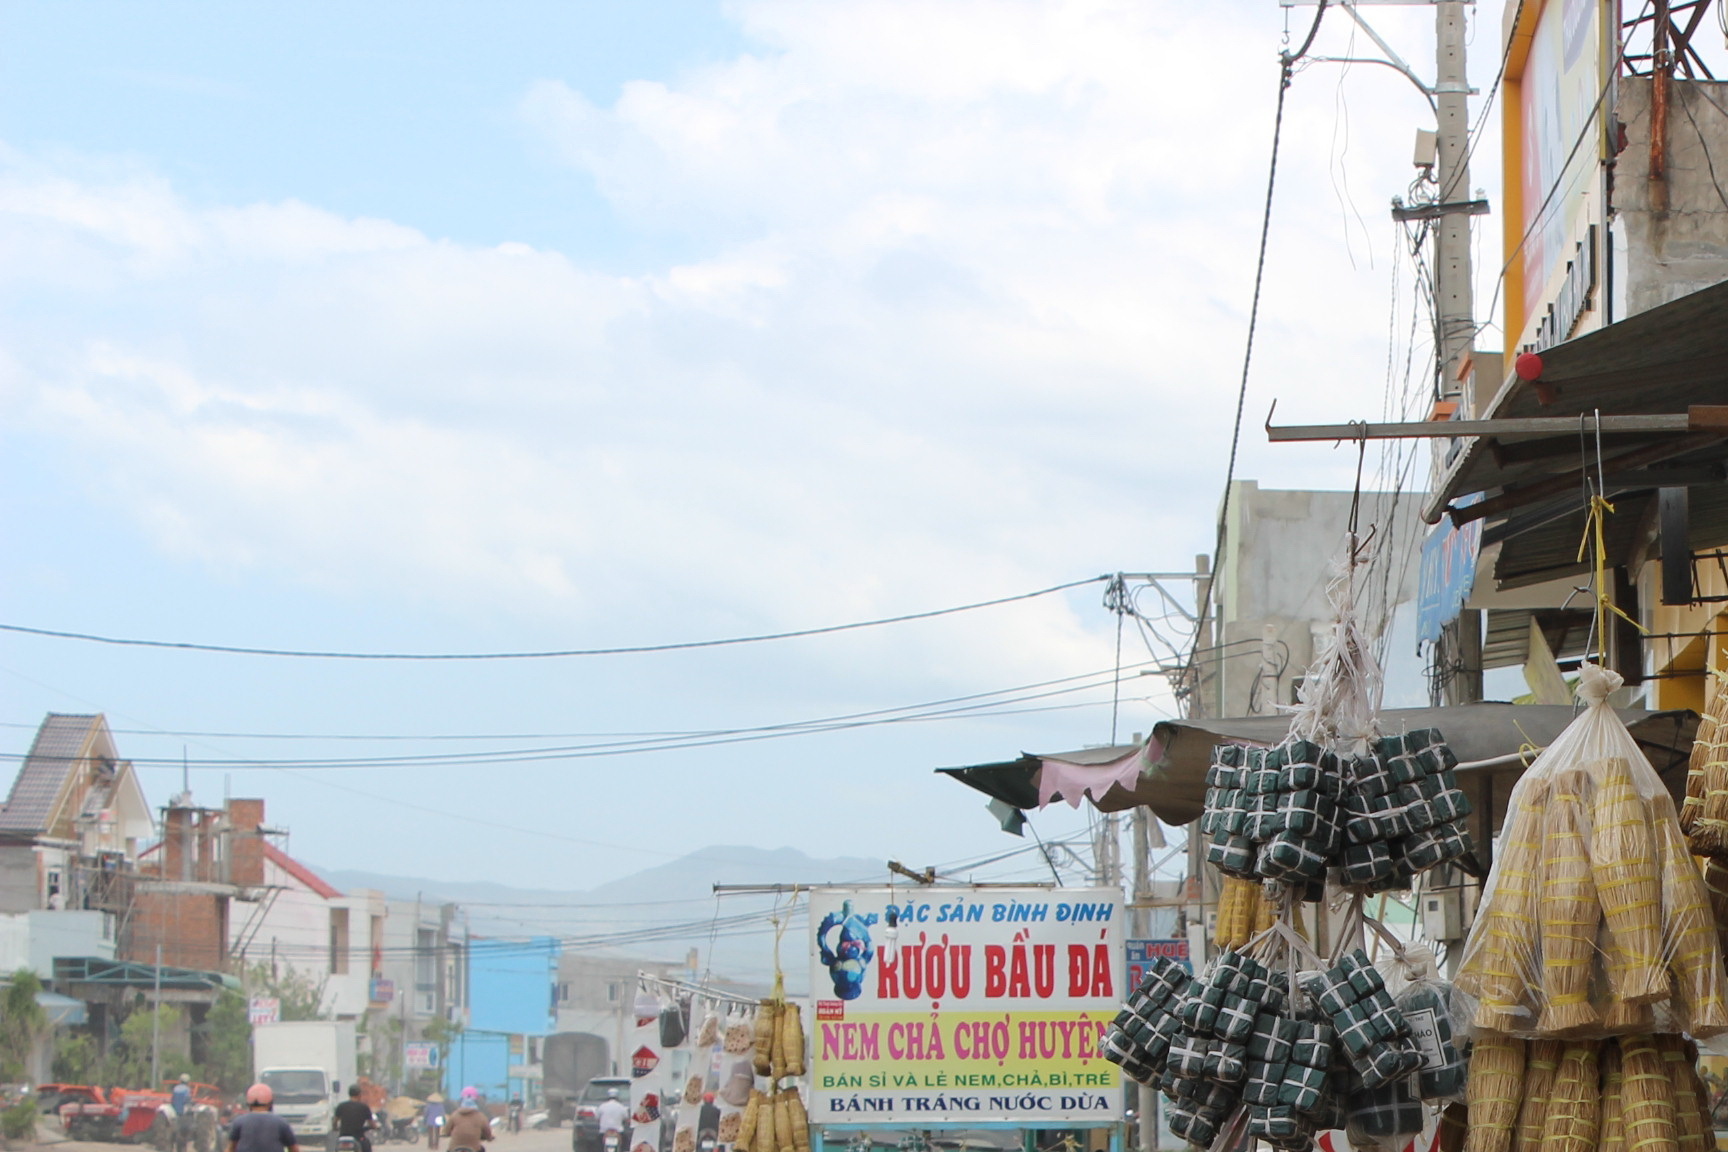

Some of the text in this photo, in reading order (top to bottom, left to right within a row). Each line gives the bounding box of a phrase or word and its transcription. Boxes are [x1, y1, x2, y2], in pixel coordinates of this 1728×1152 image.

[937, 896, 984, 923] SẢN
[992, 900, 1049, 923] BÌNH
[1056, 903, 1113, 926] ĐỊNH
[877, 928, 1113, 1010] RƯỢU BẦU ĐÁ
[821, 1023, 880, 1061] NEM
[888, 1012, 945, 1060] CHẢ
[953, 1013, 1011, 1066] CHỢ
[823, 1073, 863, 1088] BÁN
[869, 1070, 886, 1087] SỈ
[894, 1073, 919, 1087] VÀ
[924, 1070, 947, 1087] LẺ
[830, 1091, 1110, 1113] BÁNH TRÁNG NƯỚC DỪA
